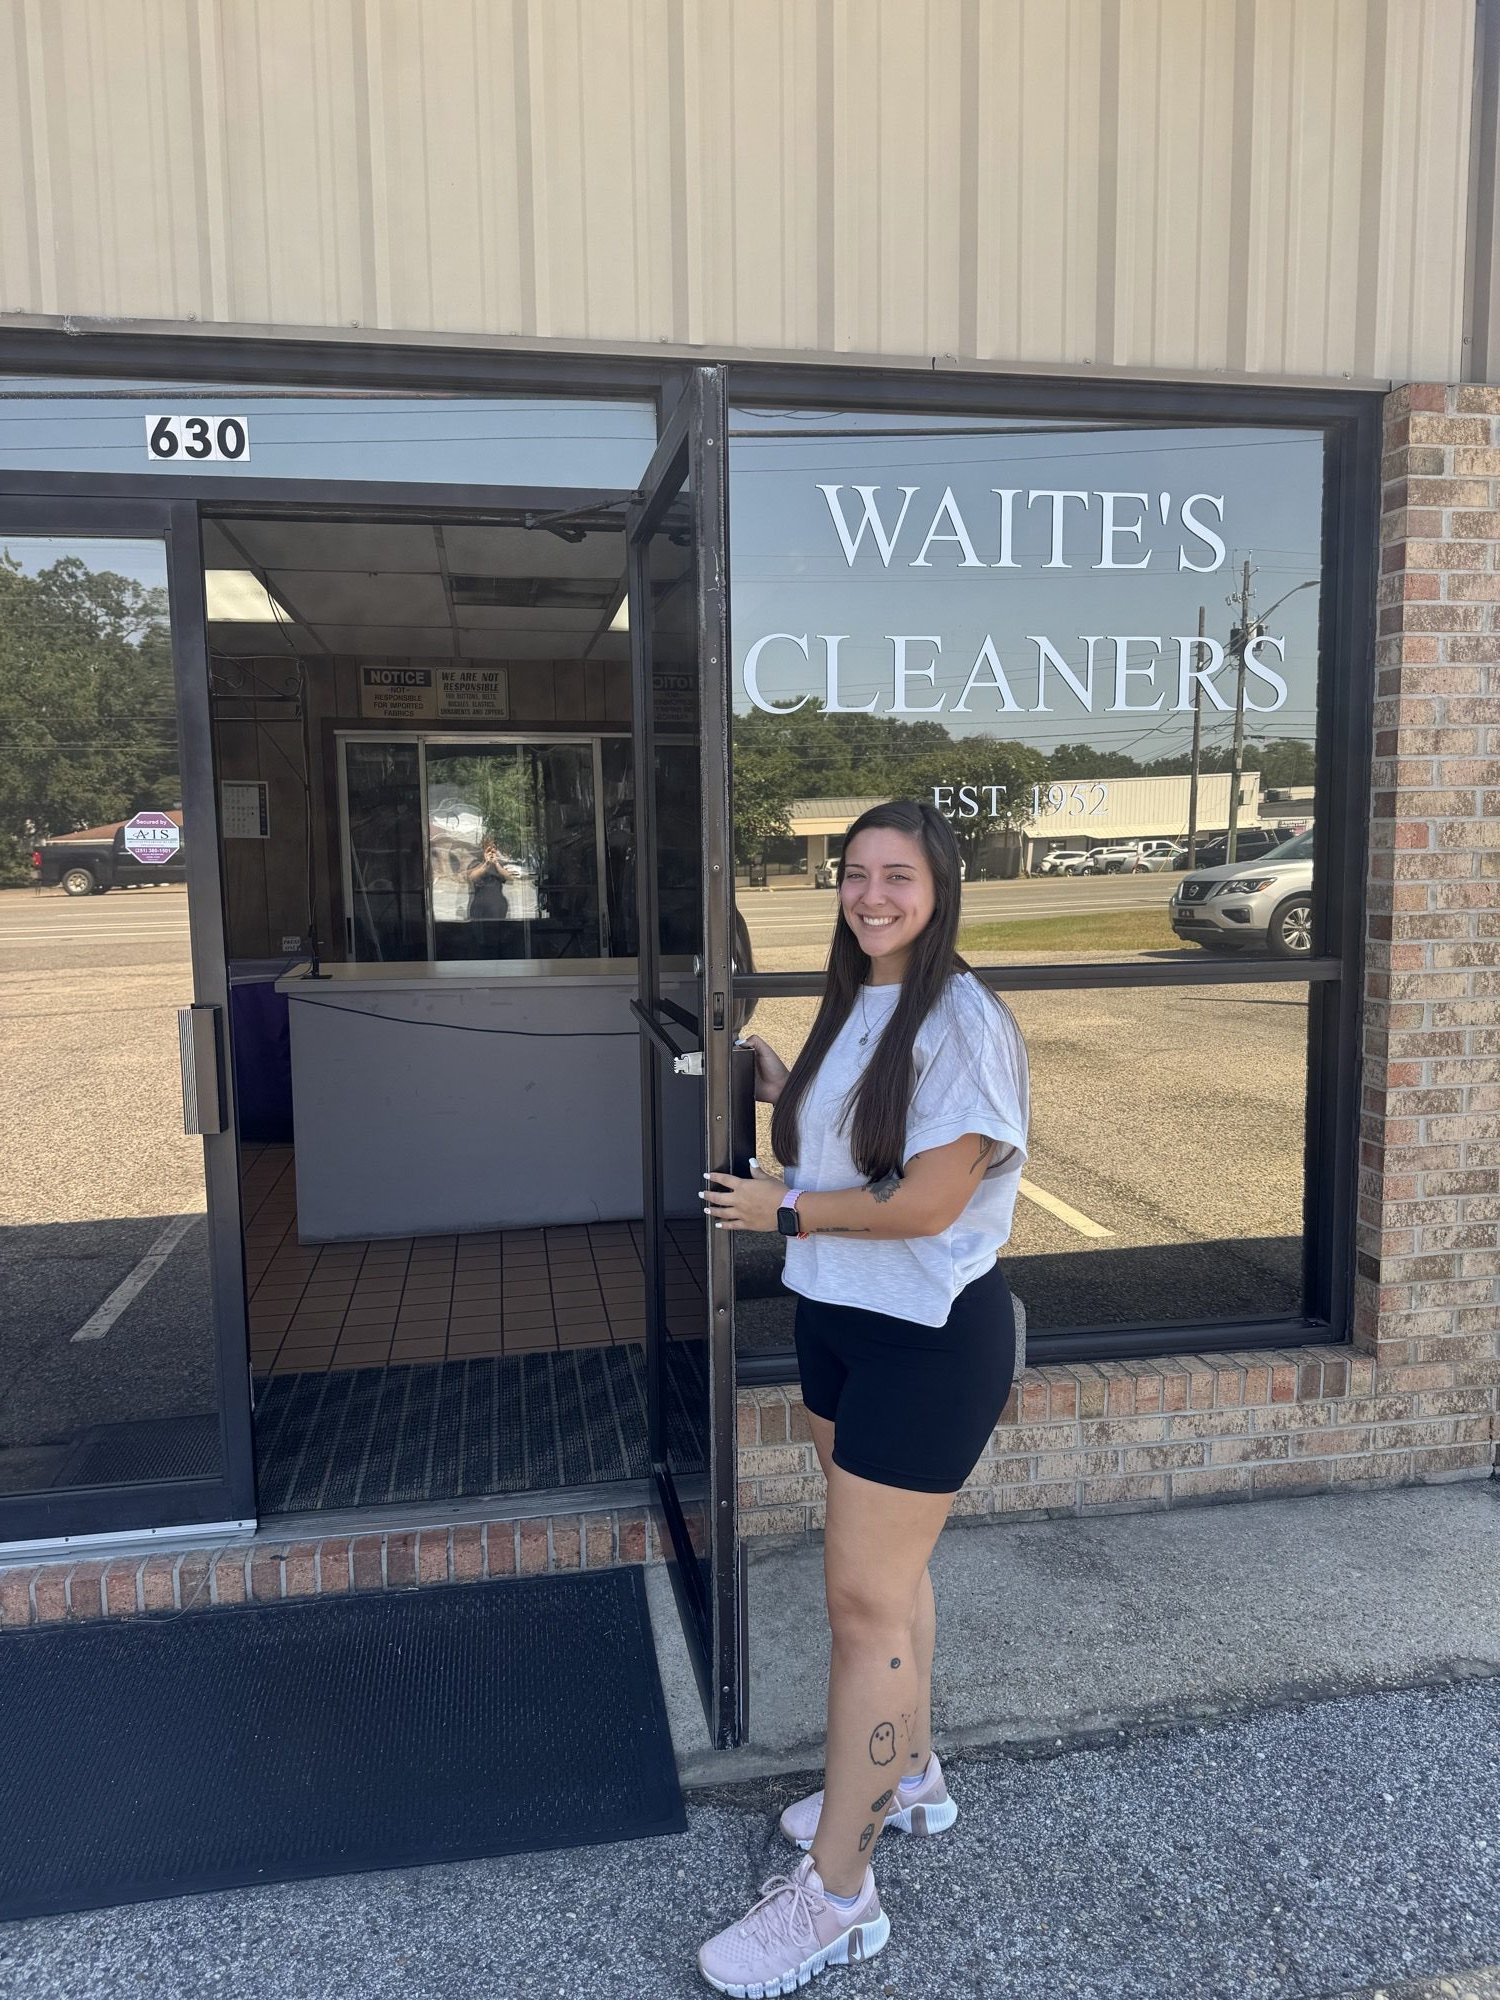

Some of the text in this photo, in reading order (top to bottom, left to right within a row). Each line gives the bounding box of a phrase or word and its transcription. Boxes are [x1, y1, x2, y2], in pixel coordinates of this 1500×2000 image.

[151, 416, 246, 459] 630
[815, 484, 1227, 573] WAITE'S
[370, 670, 425, 684] NOTICE
[441, 672, 499, 682] WE ARE NOT
[742, 632, 1288, 716] CLEANERS
[443, 682, 499, 691] RESPONSIBLE
[374, 694, 422, 702] RESPONSIBLE
[389, 702, 425, 710] IMPORTED
[931, 783, 1109, 818] EST. 1952
